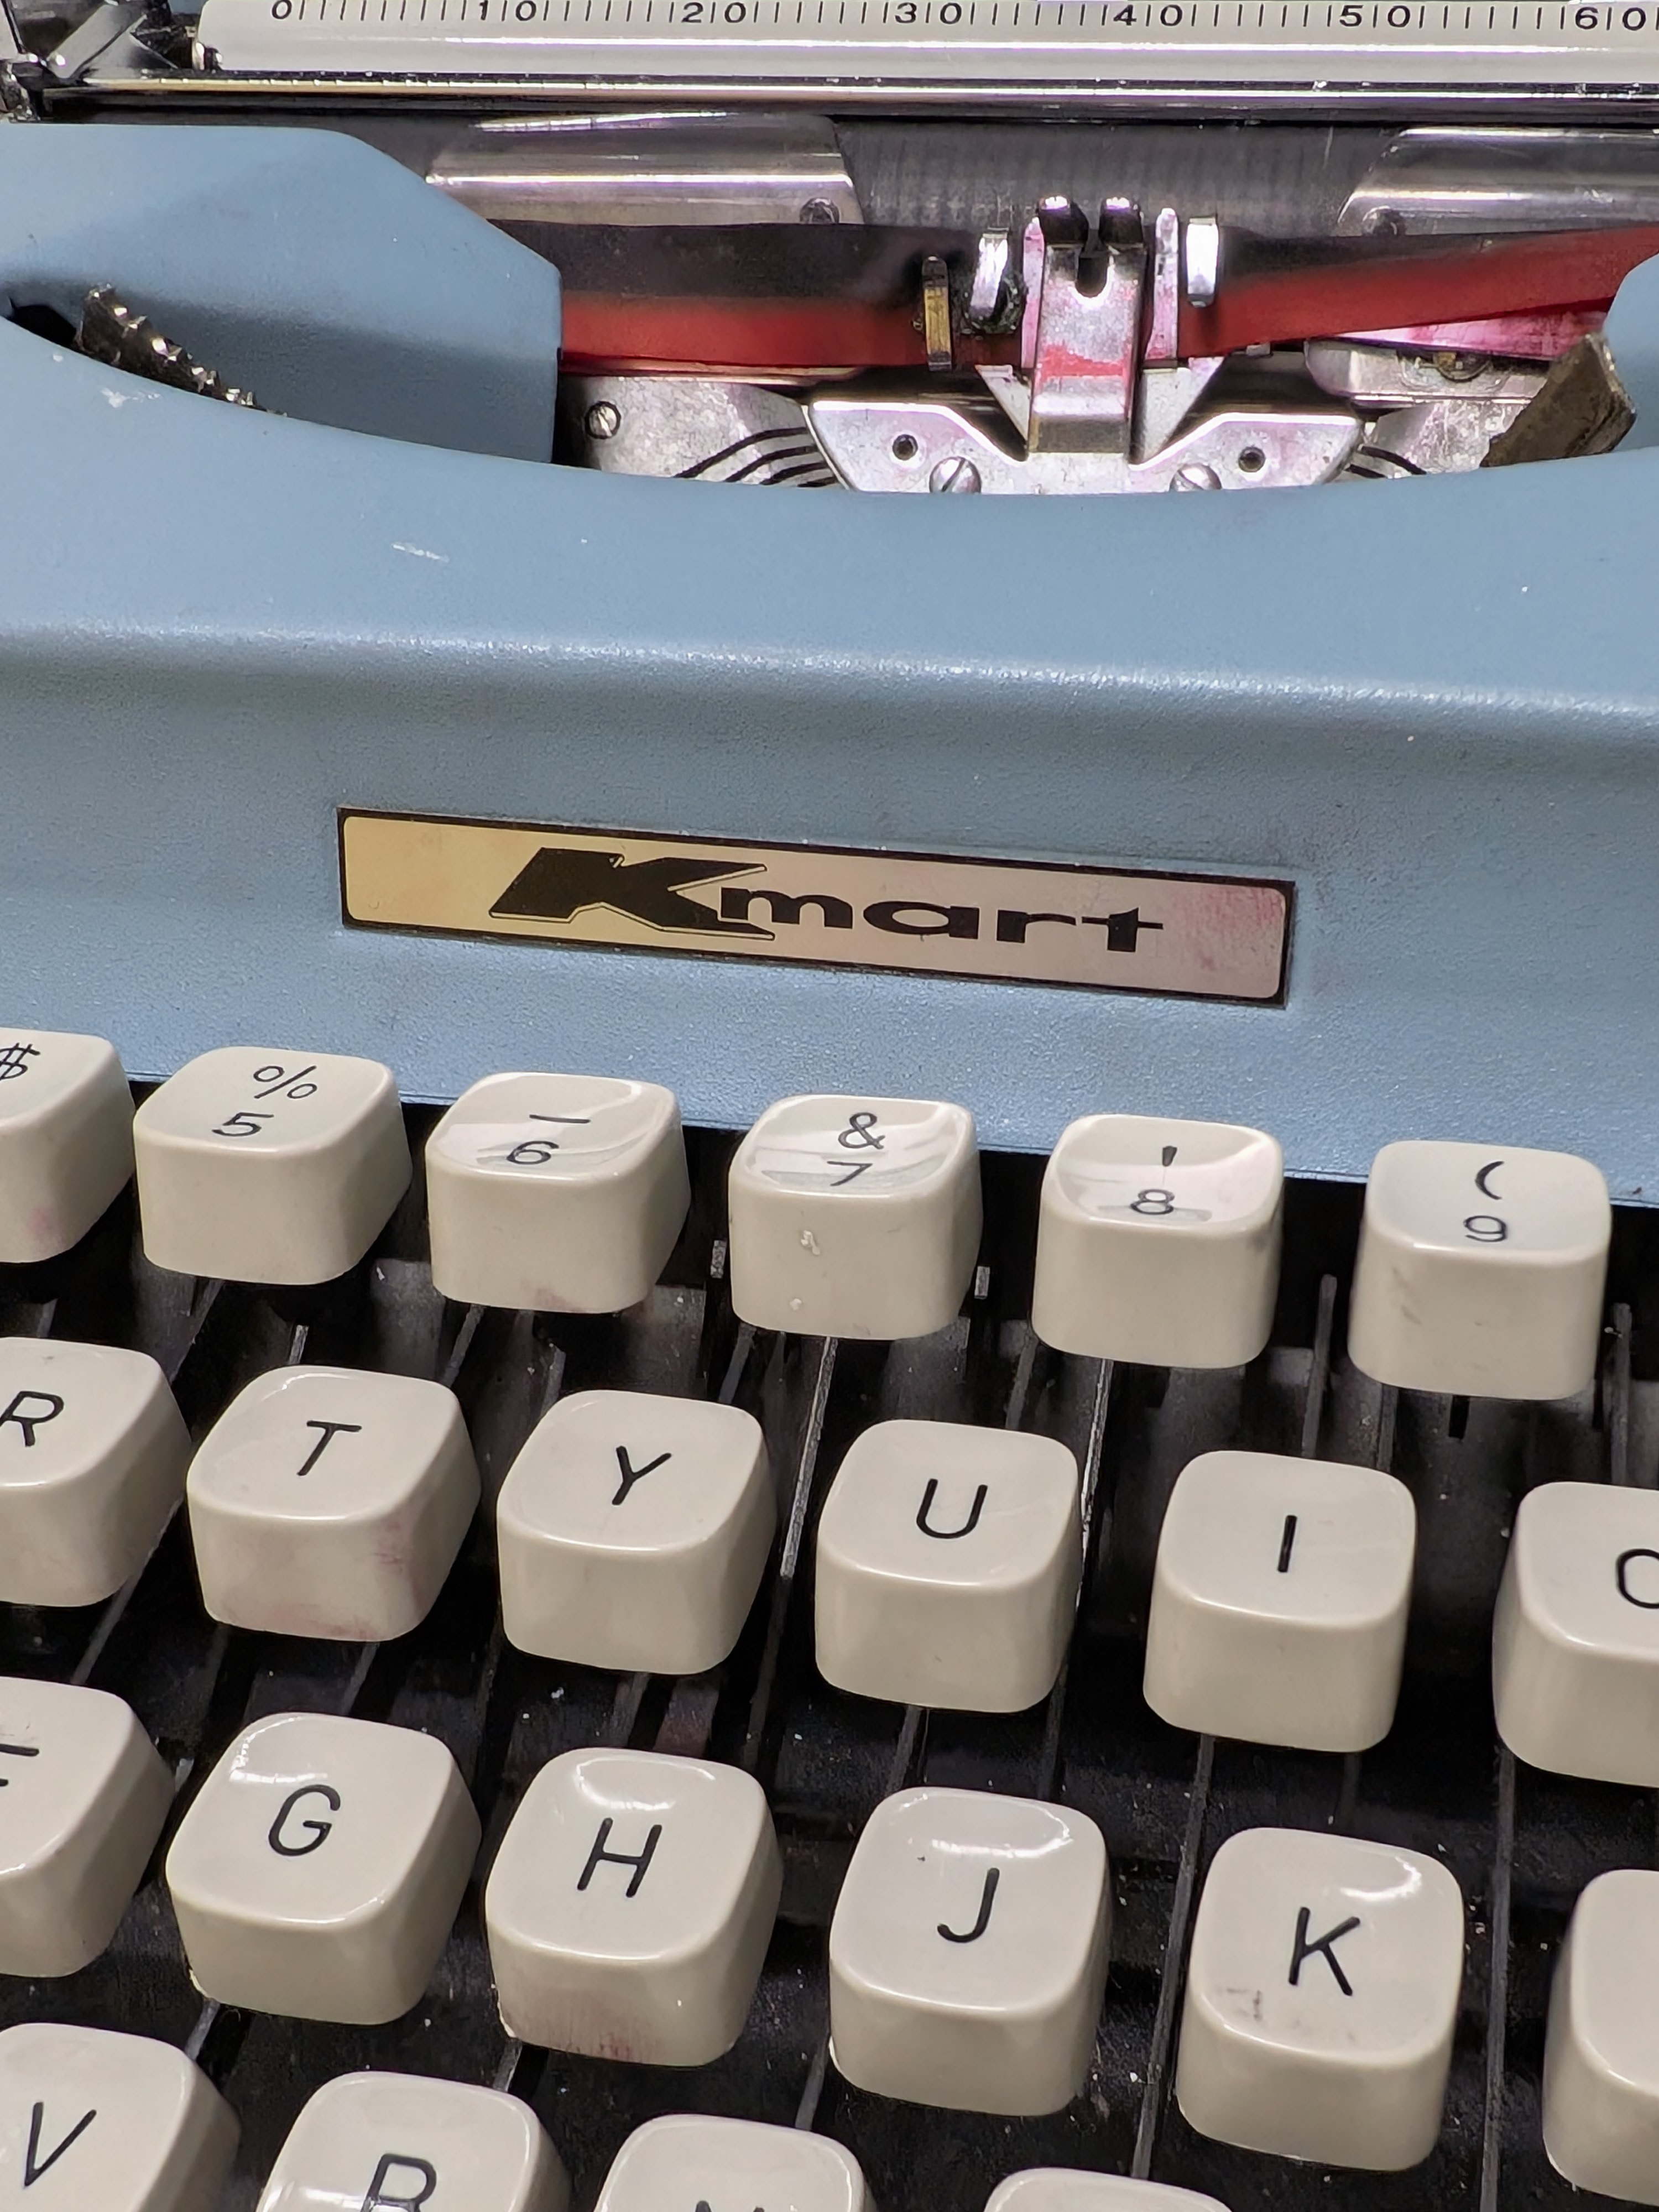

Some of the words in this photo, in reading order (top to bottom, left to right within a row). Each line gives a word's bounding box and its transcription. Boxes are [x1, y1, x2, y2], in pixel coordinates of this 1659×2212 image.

[272, 0, 291, 19] 0
[480, 0, 536, 21] 10
[682, 2, 745, 23] 20
[895, 3, 961, 24] 30
[1114, 5, 1182, 26] 40
[1339, 4, 1411, 28] 50
[1575, 7, 1646, 30] 60
[489, 847, 1164, 952] Kmart
[0, 1043, 40, 1081] $
[253, 1066, 317, 1099] %
[212, 1113, 273, 1136] 5
[838, 1112, 885, 1149] &
[507, 1141, 559, 1164] 6
[827, 1161, 872, 1186] 7
[1475, 1161, 1503, 1199] (
[1130, 1190, 1175, 1215] 8
[1464, 1215, 1507, 1242] 9
[0, 1391, 64, 1447] R
[298, 1421, 362, 1476] T
[612, 1446, 671, 1505] Y
[916, 1479, 988, 1539] U
[1278, 1515, 1297, 1573] I
[269, 1785, 340, 1856] G
[577, 1818, 662, 1897] H
[937, 1868, 999, 1943] J
[1288, 1907, 1360, 1996] K
[24, 2103, 96, 2187] V
